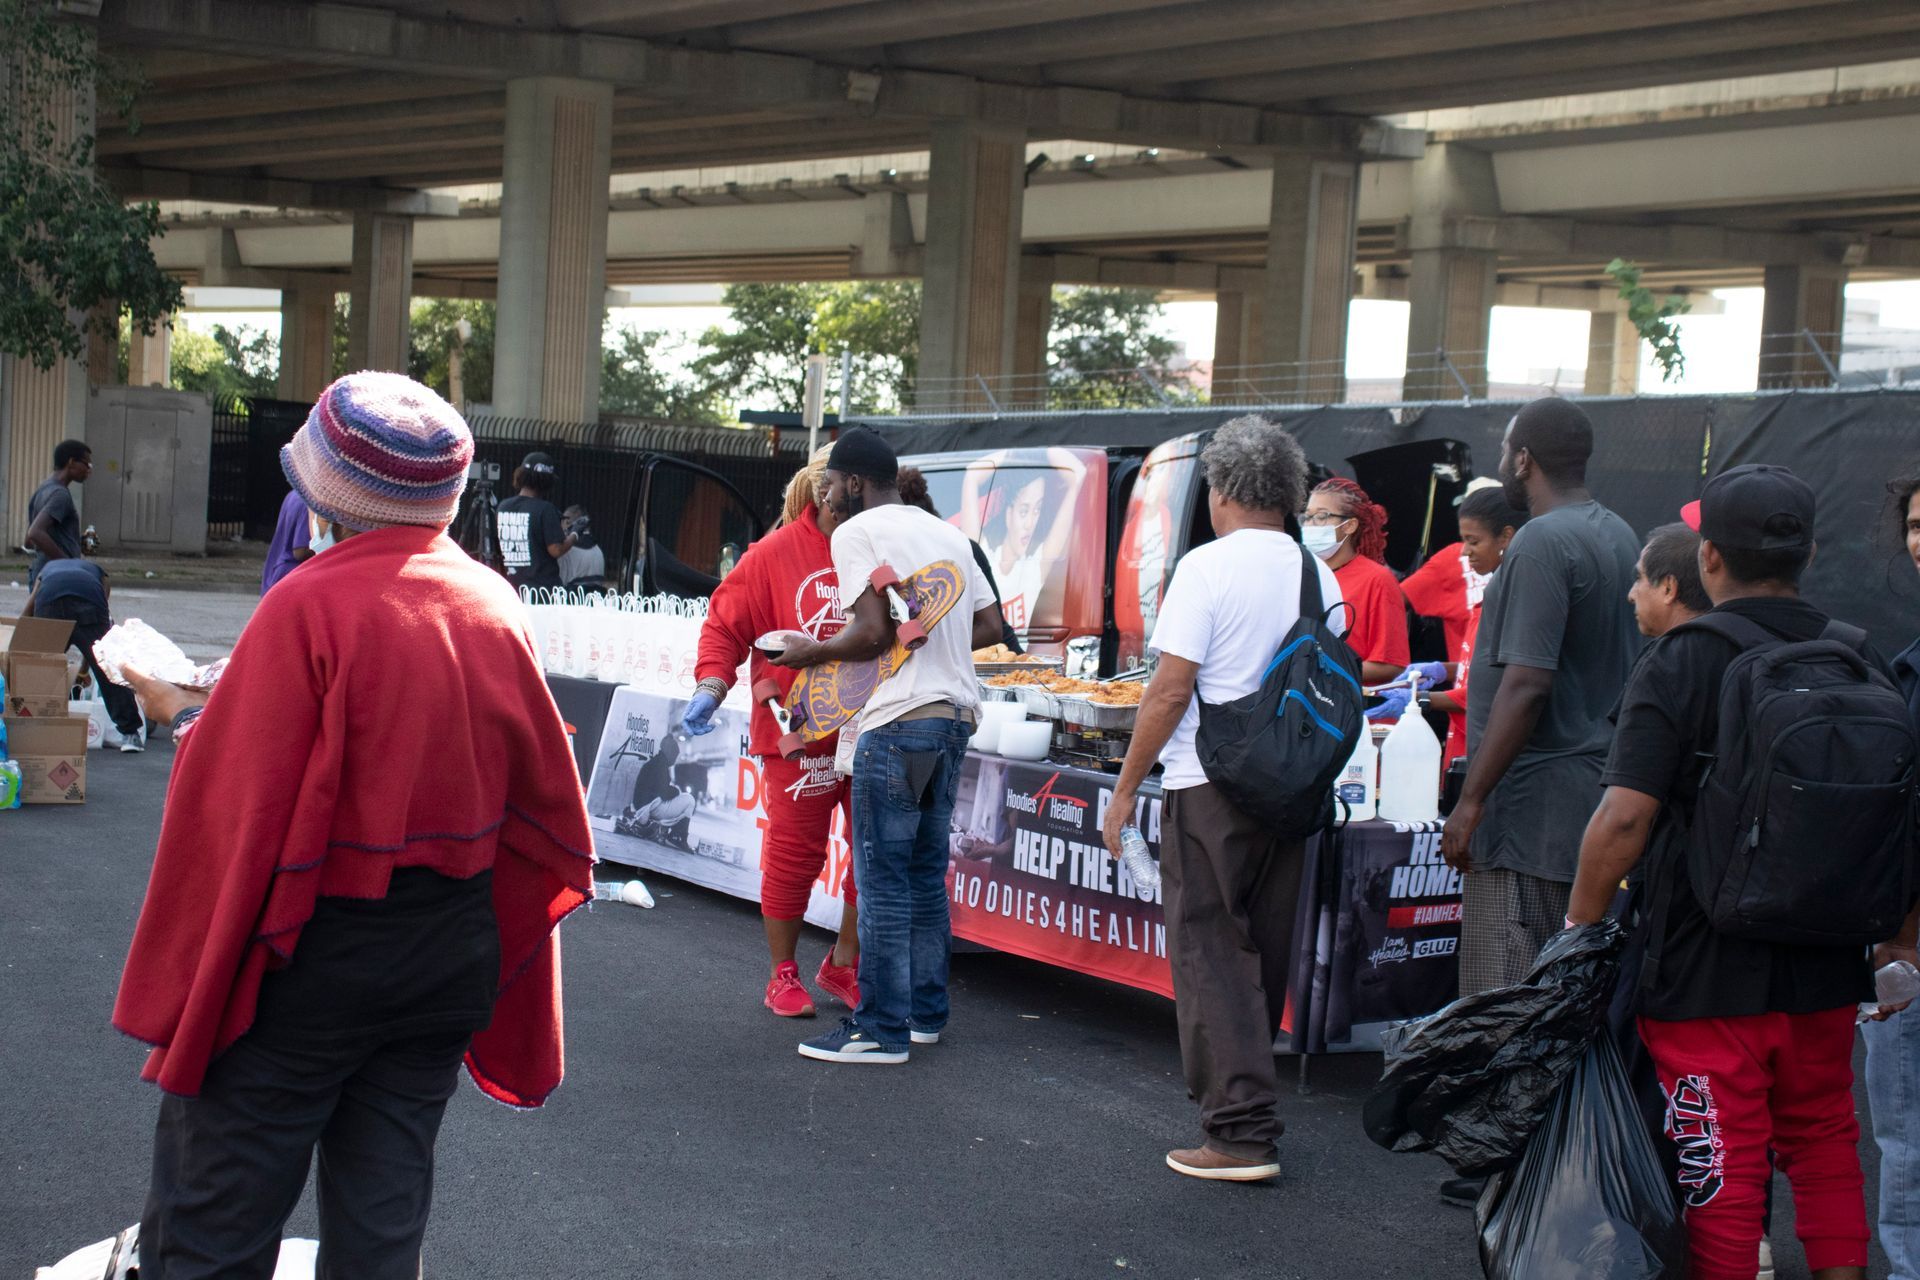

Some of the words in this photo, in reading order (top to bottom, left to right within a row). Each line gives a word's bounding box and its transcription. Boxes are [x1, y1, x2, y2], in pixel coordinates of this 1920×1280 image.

[500, 541, 515, 553] ELP
[626, 712, 650, 733] Hoodies
[630, 732, 655, 758] Healing
[1006, 788, 1037, 814] Hoodies
[1050, 797, 1083, 828] Healing
[1013, 828, 1065, 880] HELP
[1069, 841, 1113, 894] THE
[1409, 832, 1446, 865] HE
[954, 871, 1166, 959] HOODIES4HEALIN
[1413, 904, 1463, 925] #IAMHEA
[1418, 940, 1455, 955] GLUE
